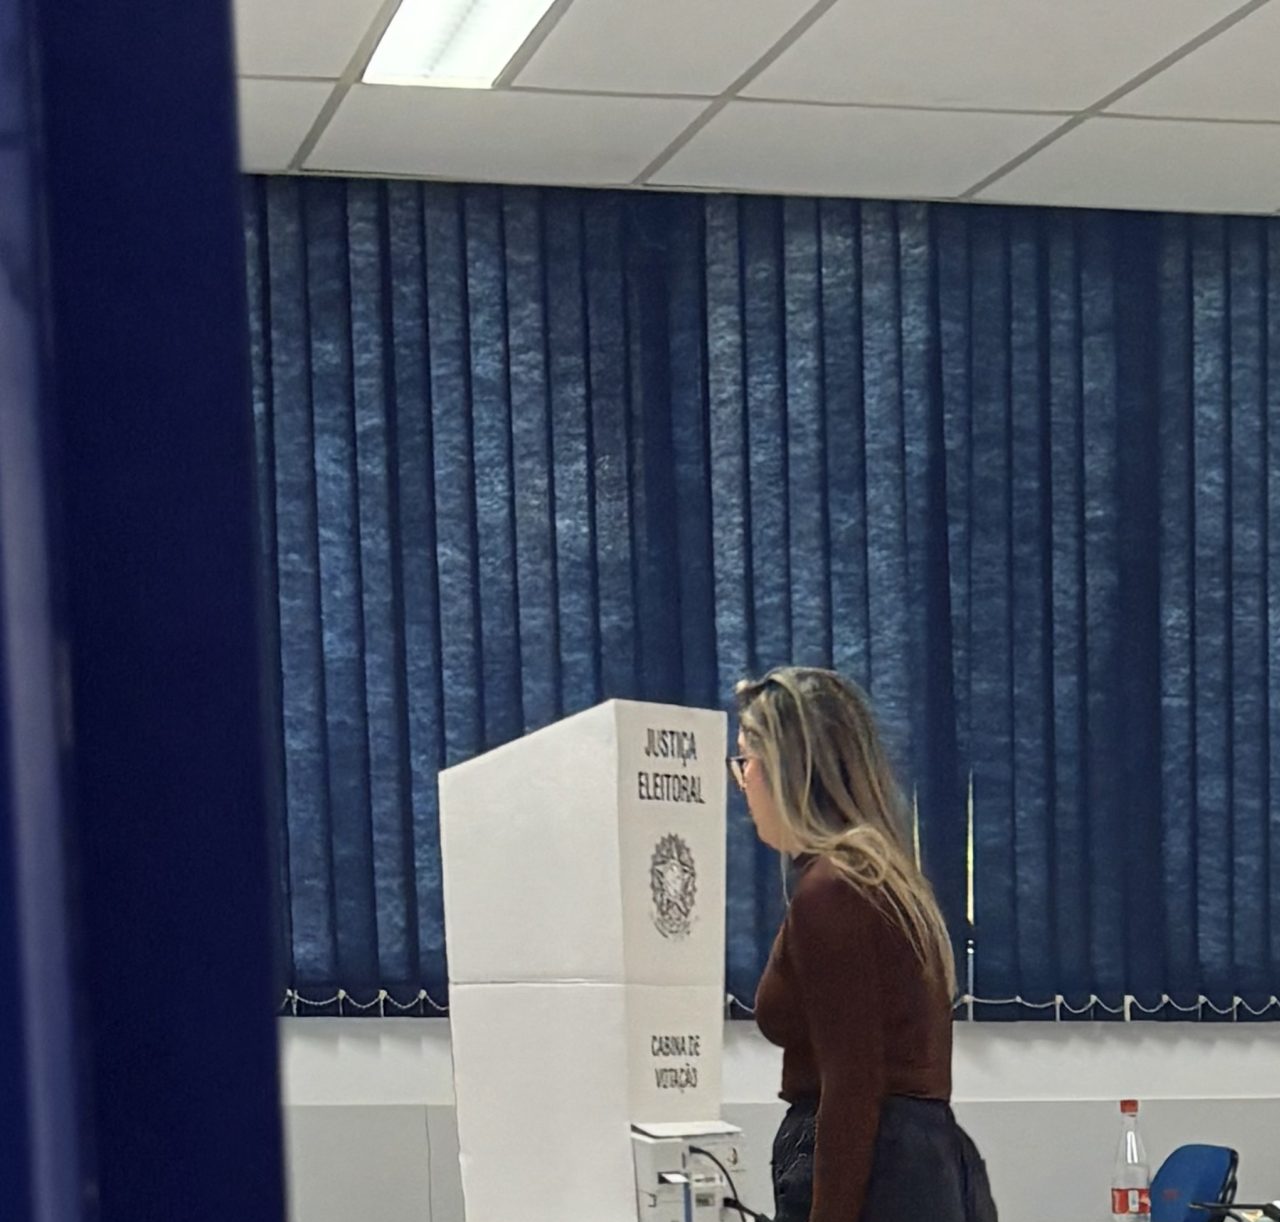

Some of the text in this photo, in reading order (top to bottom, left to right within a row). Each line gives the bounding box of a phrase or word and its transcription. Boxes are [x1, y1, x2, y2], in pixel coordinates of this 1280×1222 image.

[644, 728, 697, 767] JUSTIÇA
[638, 771, 706, 804] ELEITORAL
[651, 1035, 701, 1057] CABINA DE
[655, 1063, 698, 1093] VOTAÇÃO
